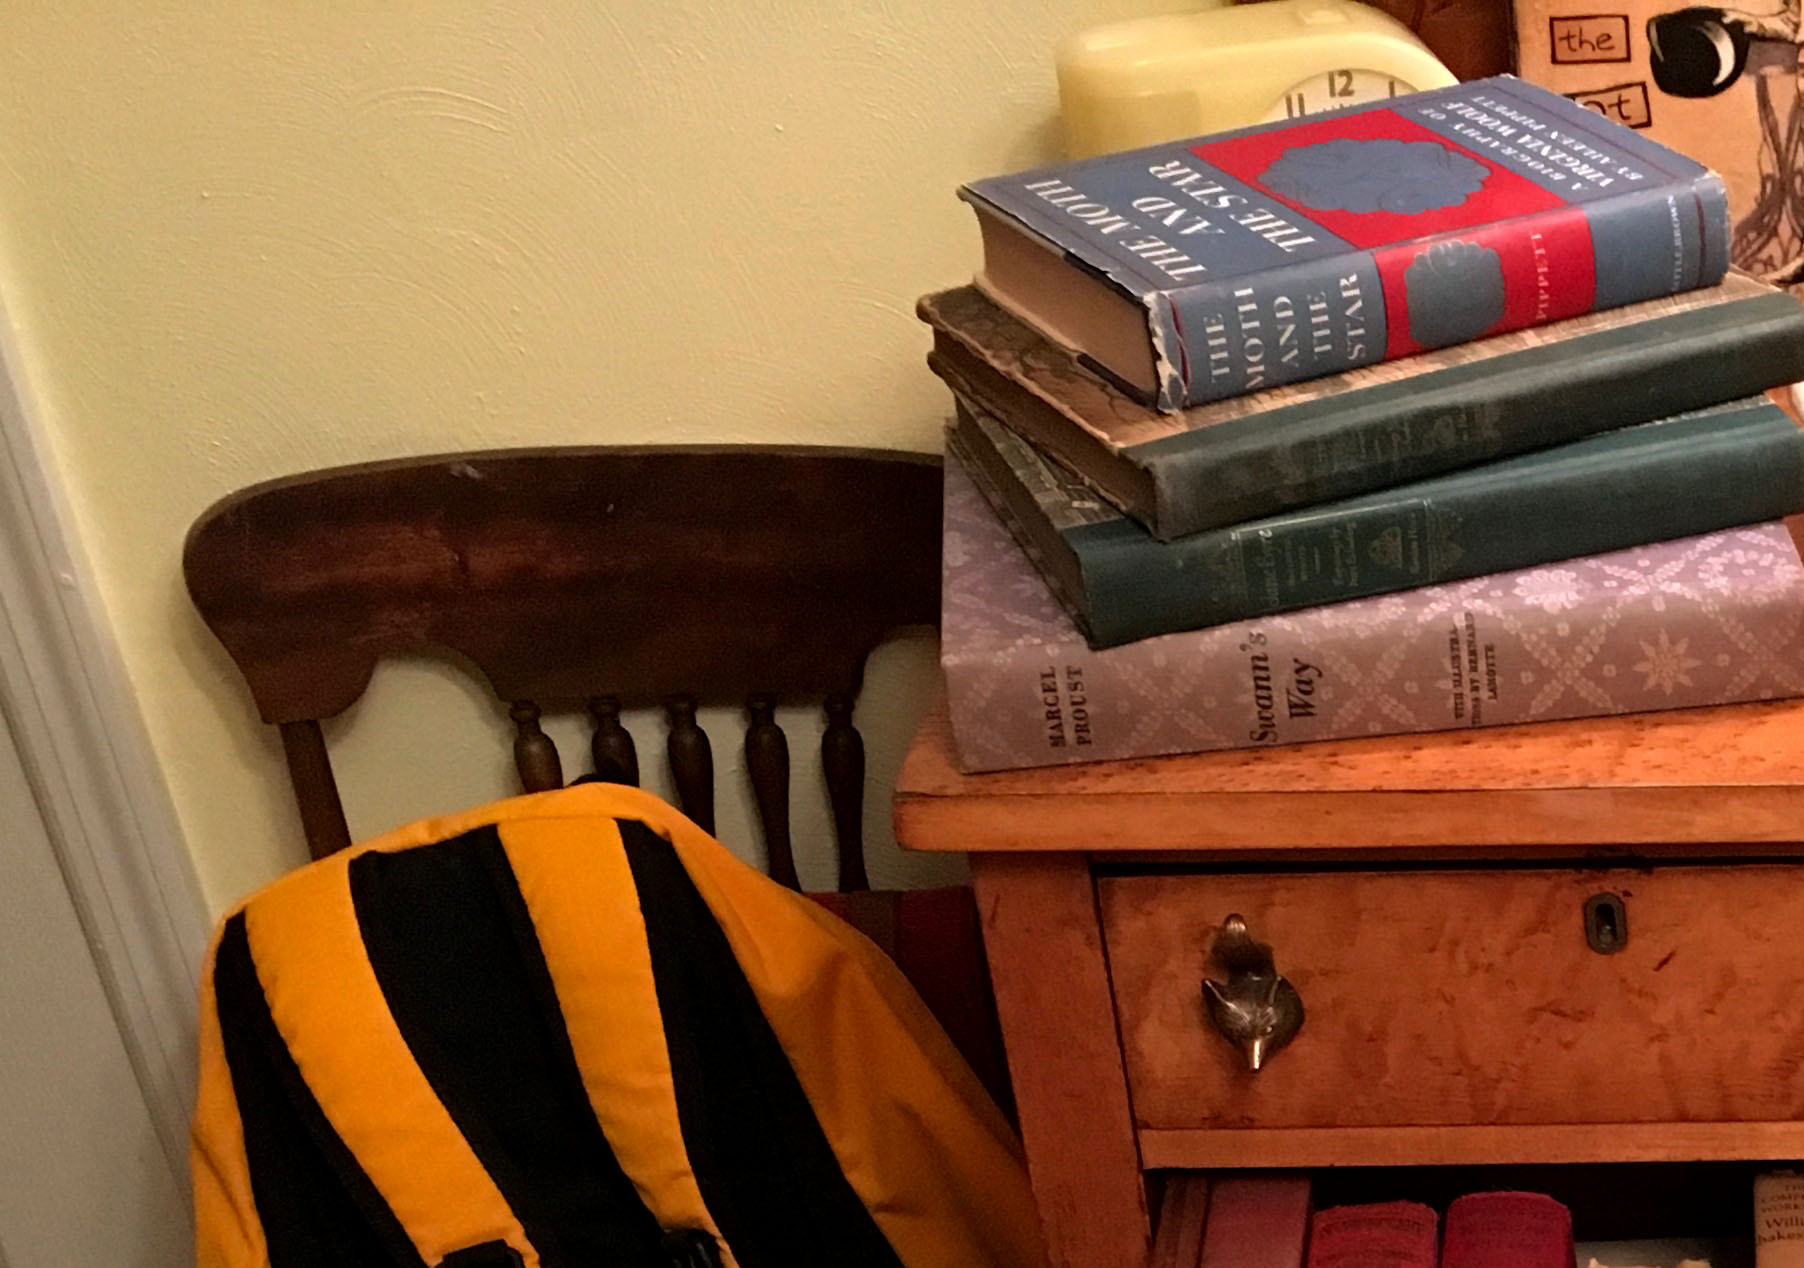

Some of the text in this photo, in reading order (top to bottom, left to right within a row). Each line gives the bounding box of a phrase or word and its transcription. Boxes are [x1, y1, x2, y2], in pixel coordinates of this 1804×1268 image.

[1559, 27, 1615, 52] the
[1328, 71, 1355, 98] 12
[1418, 107, 1447, 121] OF
[1443, 101, 1615, 188] VIRGINIA WOOLF
[1452, 122, 1567, 181] BIOGRAPHY
[1471, 95, 1644, 181] BY AILEEN PIPPETT
[1024, 179, 1206, 281] THE MOTH
[1132, 196, 1226, 235] AND
[1149, 160, 1316, 252] THE STAR
[1339, 272, 1366, 360] STAR
[1531, 231, 1549, 319] PIPPETT
[1203, 313, 1230, 384] THE
[1234, 288, 1266, 389] MOTH
[1273, 296, 1299, 367] AND
[1306, 291, 1332, 360] THE
[1040, 665, 1066, 748] MARCEL
[1067, 665, 1091, 747] PROUST
[1240, 631, 1277, 743] Swann's
[1287, 658, 1322, 719] Way
